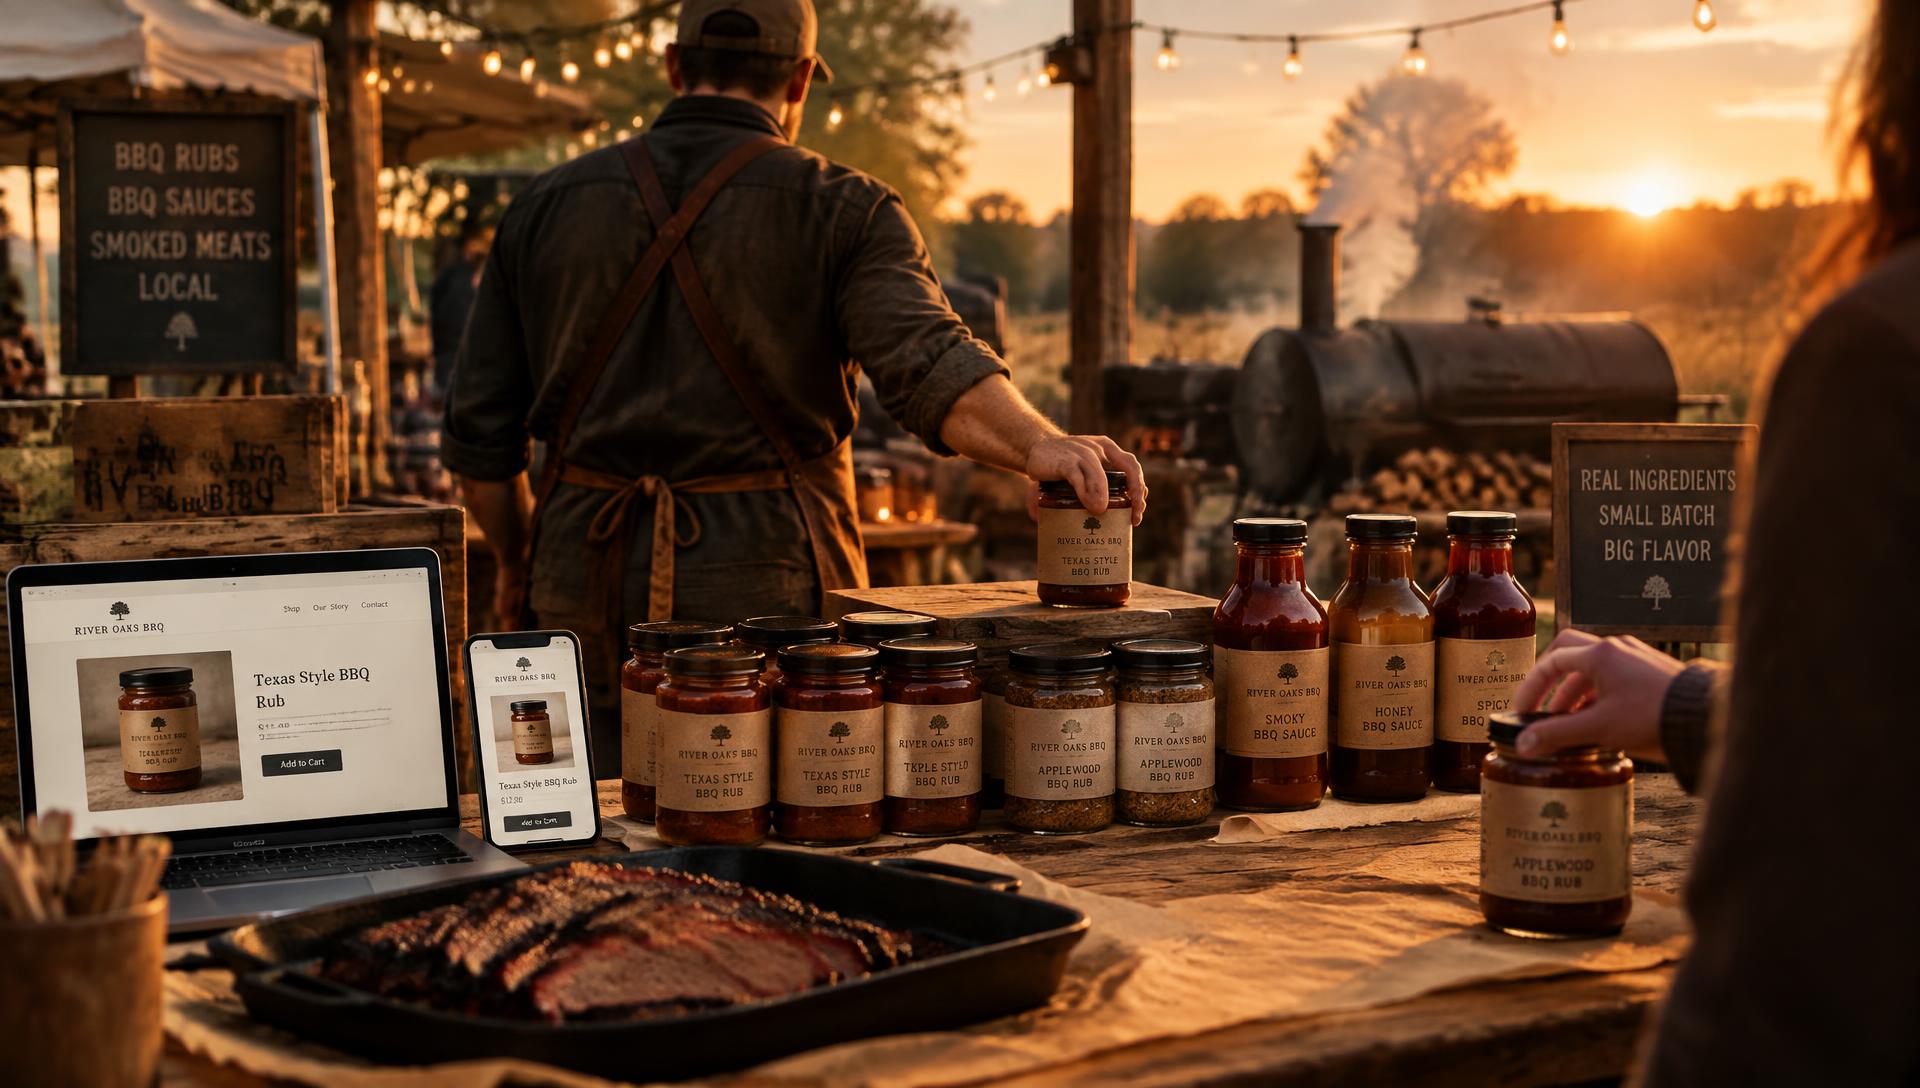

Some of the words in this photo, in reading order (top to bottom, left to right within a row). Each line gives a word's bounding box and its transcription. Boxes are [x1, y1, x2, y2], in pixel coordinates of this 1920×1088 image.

[114, 141, 165, 174] BBQ
[175, 142, 240, 172] RUBS
[108, 186, 157, 218] BBQ
[165, 186, 256, 217] SAUCES
[91, 230, 187, 260] SMOKED
[195, 230, 272, 260] MEATS
[138, 271, 219, 301] LOCAL
[1581, 469, 1622, 491] REAL
[1629, 469, 1736, 491] INGREDIENTS
[1599, 504, 1654, 526] SMALL
[1661, 504, 1715, 526] BATCH
[1604, 539, 1634, 561] BIG
[1642, 539, 1711, 561] FLAVOR
[1062, 556, 1090, 565] TEXAS
[1094, 556, 1119, 565] STYLE
[1071, 568, 1090, 576] BBQ
[1093, 568, 1110, 576] RUB
[330, 603, 349, 612] Story
[74, 625, 109, 635] RIVER
[254, 673, 295, 687] Texas
[299, 669, 335, 686] Style
[339, 667, 371, 682] BBQ
[495, 675, 517, 683] RIVER
[1355, 680, 1384, 689] RIVER
[1247, 688, 1276, 698] RIVER
[1279, 688, 1304, 697] OAKS
[1306, 687, 1321, 697] BBQ
[256, 694, 285, 709] Rub
[1477, 699, 1510, 711] SPICY
[1375, 706, 1413, 717] HONEY
[1265, 713, 1305, 725] SMOKY
[1462, 716, 1485, 727] BBQ
[1363, 721, 1386, 733] BBQ
[1391, 720, 1423, 731] SAUCE
[1254, 729, 1278, 741] BBQ
[1283, 727, 1317, 740] SAUCE
[899, 740, 928, 749] RIVER
[1031, 742, 1060, 752] RIVER
[1063, 742, 1087, 752] OAKS
[1089, 741, 1106, 751] BBQ
[1134, 736, 1163, 746] RIVER
[1192, 735, 1207, 745] BBQ
[678, 751, 708, 760] RIVER
[711, 750, 738, 760] OAKS
[741, 748, 758, 758] BBQ
[798, 747, 827, 757] RIVER
[831, 747, 856, 757] OAKS
[281, 759, 296, 769] Add
[308, 758, 325, 766] Cart
[1140, 757, 1202, 769] APPLEWOOD
[803, 770, 838, 781] TEXAS
[842, 768, 871, 780] STYLE
[1038, 764, 1101, 776] APPLEWOOD
[684, 773, 719, 785] TEXAS
[723, 772, 753, 784] STYLE
[915, 777, 936, 787] BBQ
[941, 775, 960, 786] RUB
[1150, 772, 1171, 782] BBQ
[1175, 771, 1195, 781] RUB
[523, 780, 542, 790] Style
[816, 785, 838, 796] BBQ
[842, 783, 862, 793] RUB
[1047, 779, 1069, 790] BBQ
[1073, 778, 1093, 788] RUB
[696, 789, 718, 799] BBQ
[722, 787, 743, 797] RUB
[1505, 827, 1539, 841] RIVER
[1541, 830, 1574, 843] OAKS
[1578, 831, 1602, 843] BBQ
[1512, 857, 1594, 872] APPLEWOOD
[1521, 874, 1550, 890] BBQ
[1554, 875, 1582, 889] RUB
